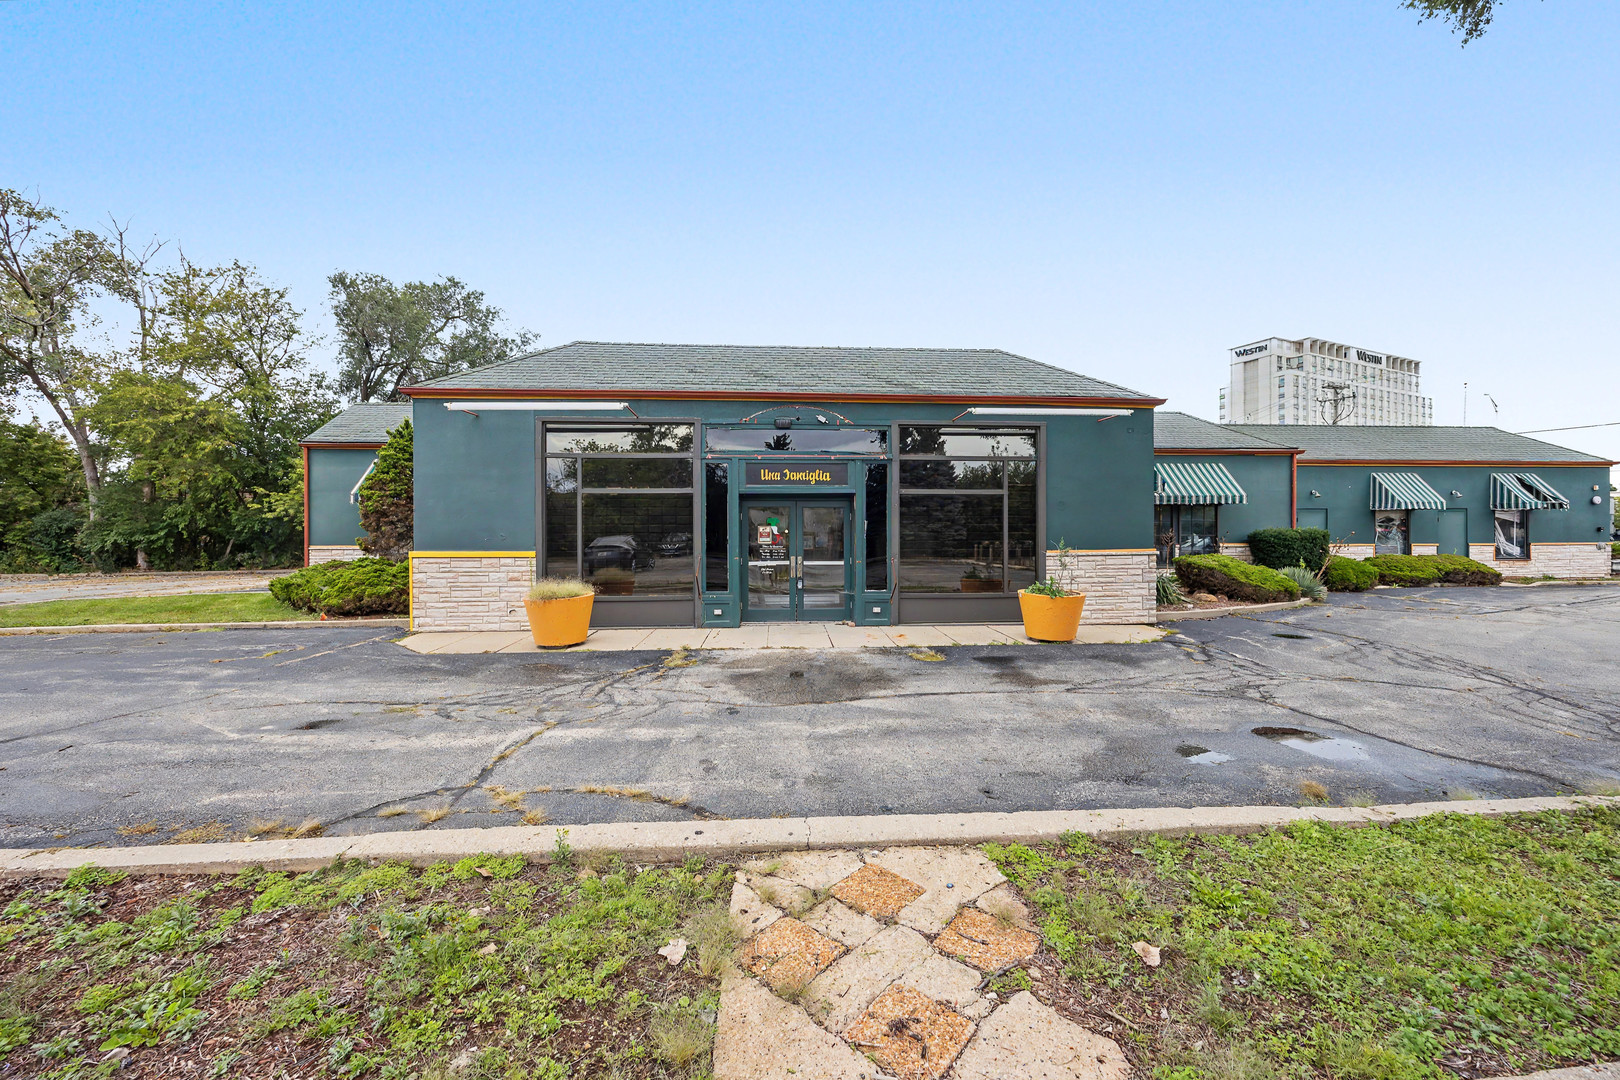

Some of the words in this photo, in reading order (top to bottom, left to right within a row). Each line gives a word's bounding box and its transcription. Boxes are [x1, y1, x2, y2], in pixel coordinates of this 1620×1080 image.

[1235, 344, 1268, 357] WESTIN
[1356, 350, 1382, 364] WESTIN
[760, 469, 780, 481] Una
